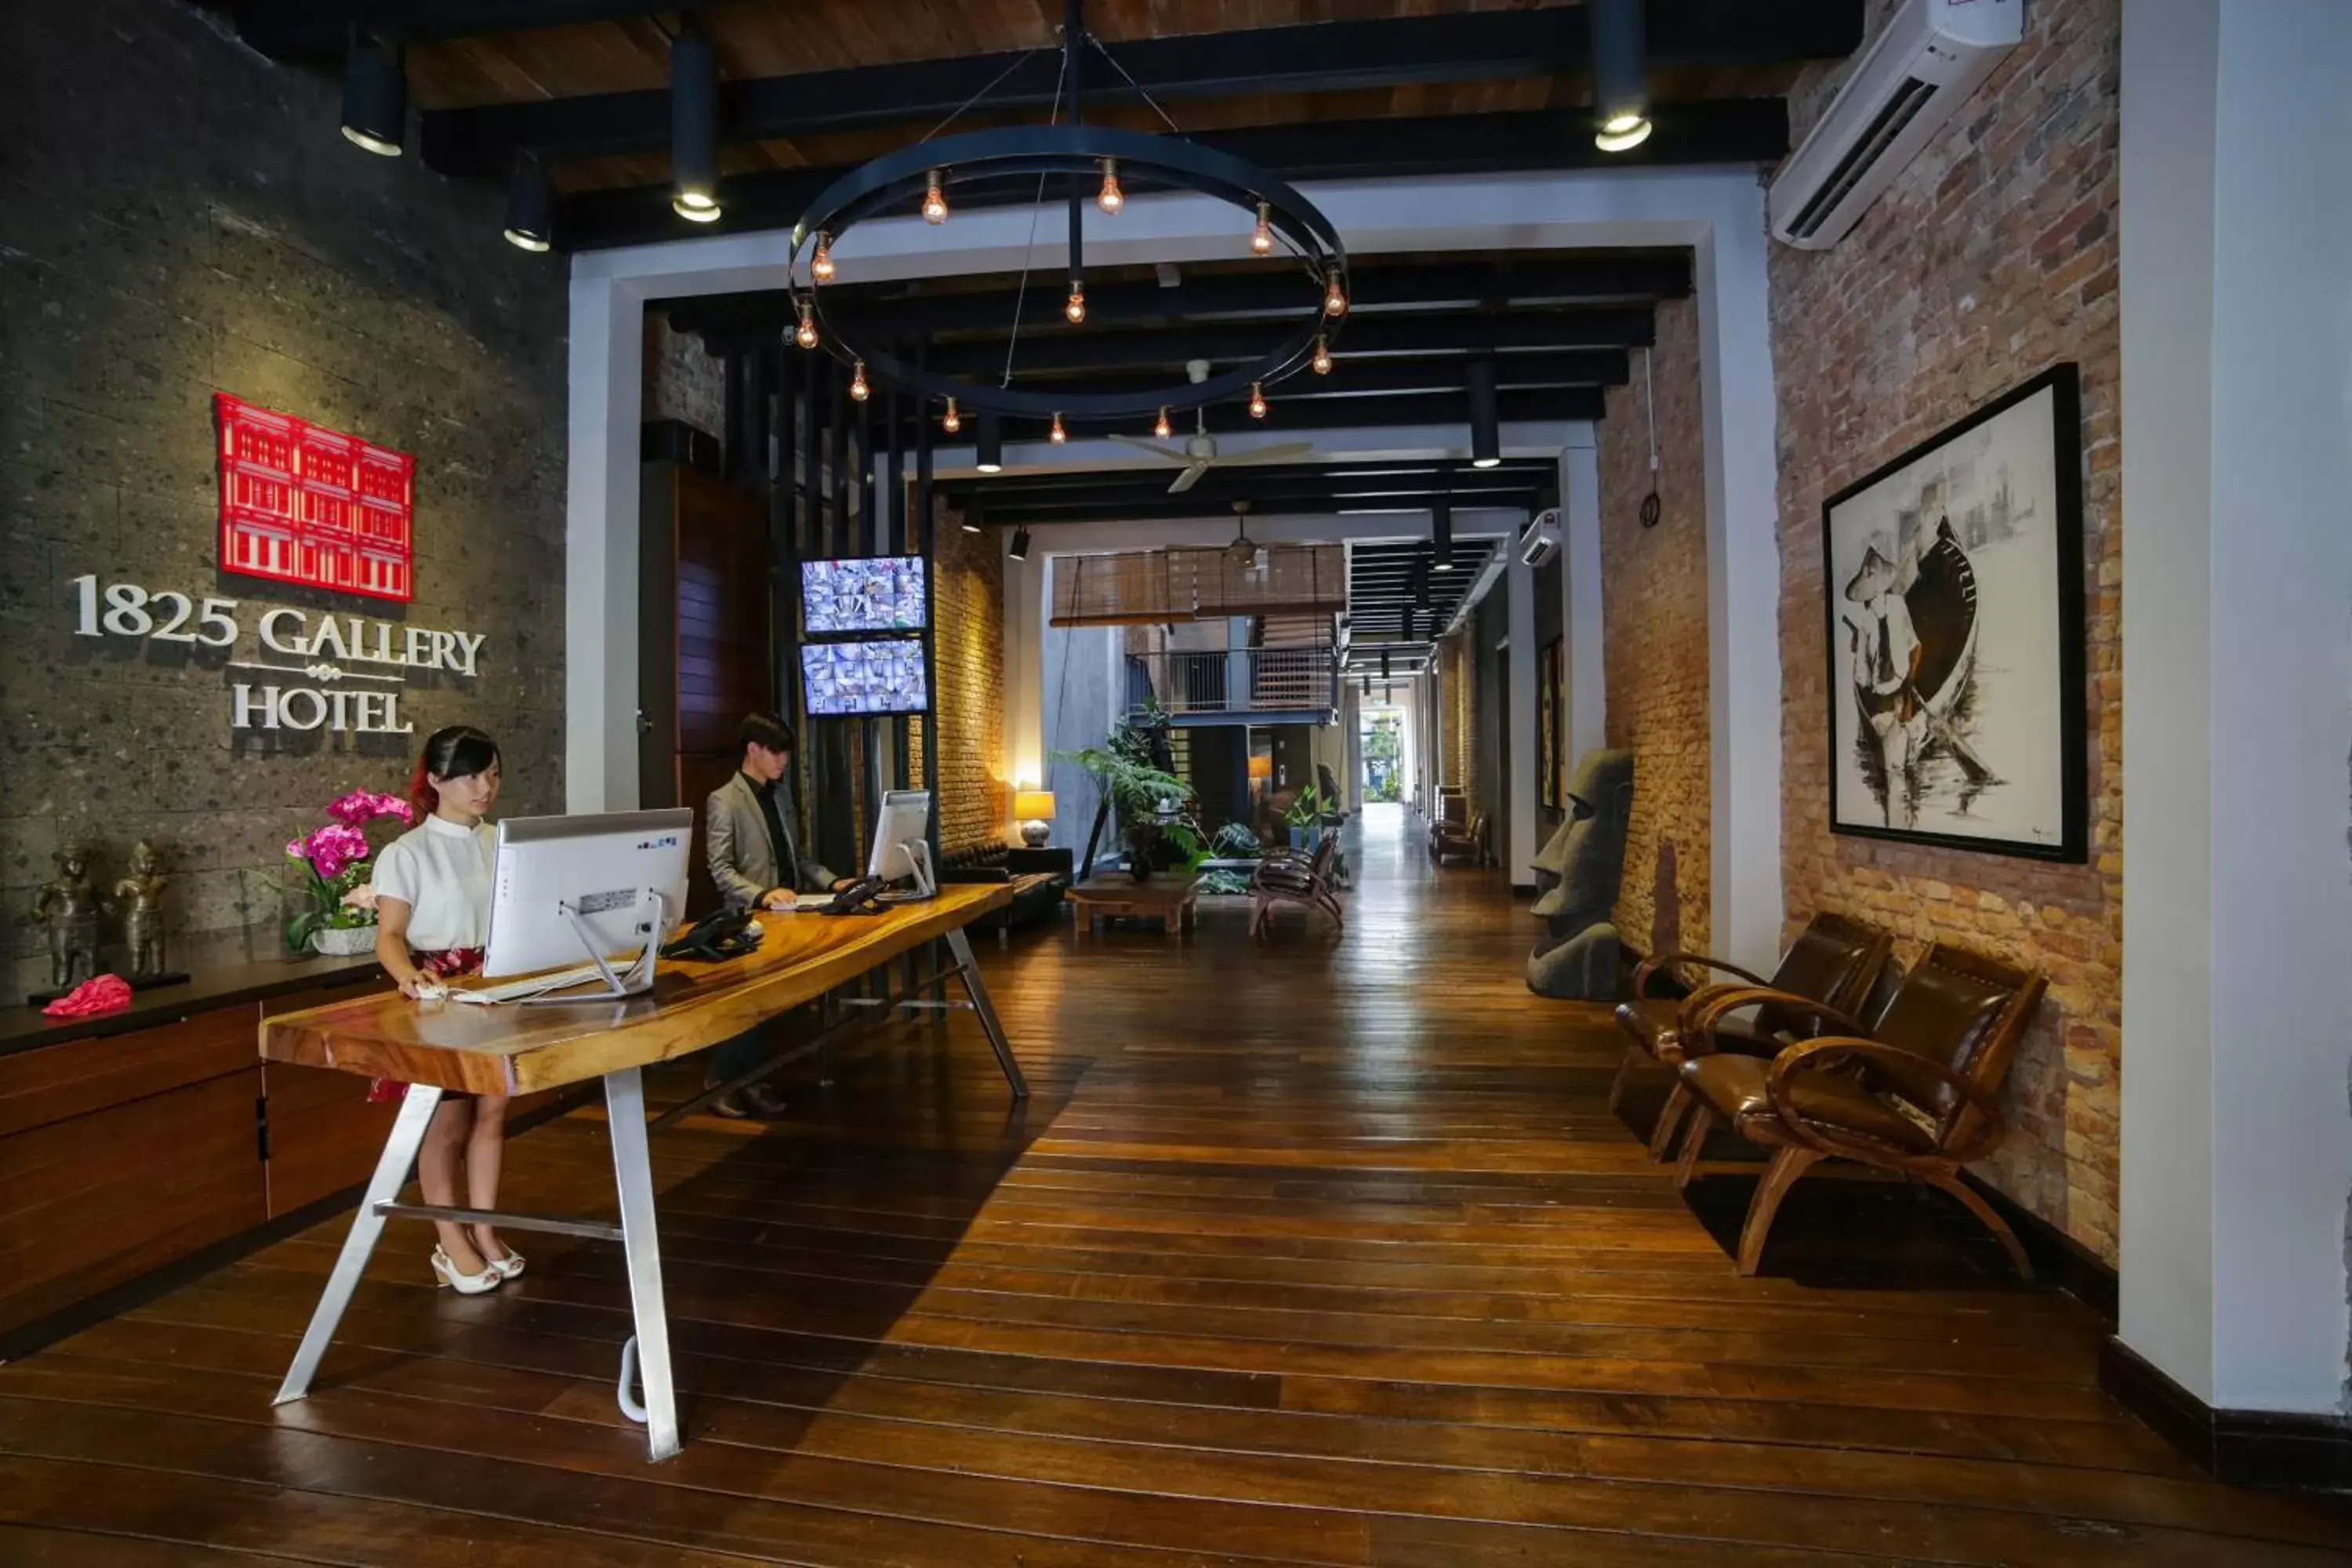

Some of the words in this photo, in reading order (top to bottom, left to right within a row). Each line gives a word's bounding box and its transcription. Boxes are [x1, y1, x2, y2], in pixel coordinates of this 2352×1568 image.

[74, 575, 238, 646] 1825
[259, 608, 486, 676] GALLERY
[233, 684, 413, 733] HOTEL
